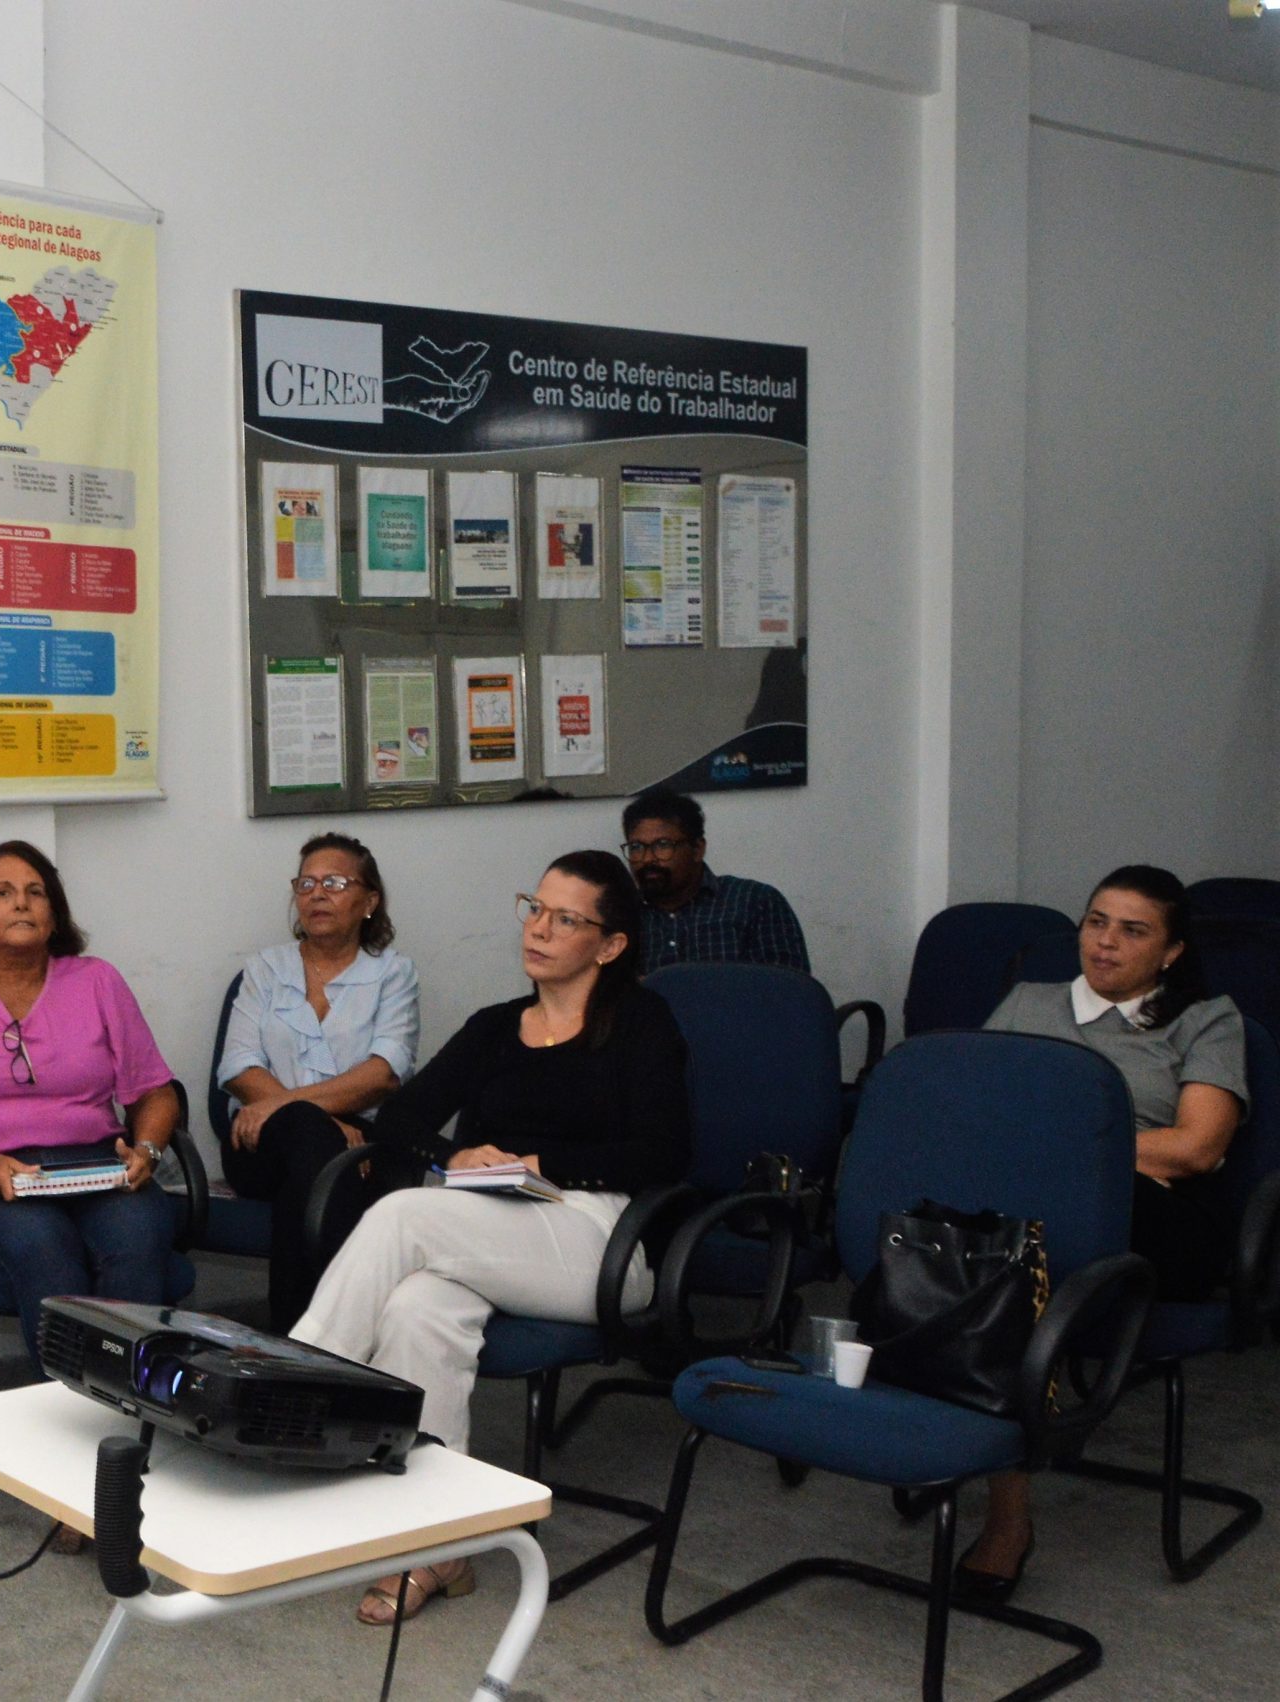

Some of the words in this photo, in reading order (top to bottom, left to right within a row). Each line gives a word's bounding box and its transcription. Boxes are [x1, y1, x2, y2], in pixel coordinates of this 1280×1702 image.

[28, 220, 52, 238] para
[56, 223, 82, 240] cada
[44, 238, 58, 253] de
[60, 240, 102, 263] Alagoas
[264, 358, 379, 409] CEREST
[508, 350, 580, 380] Centro
[584, 355, 608, 382] de
[614, 360, 716, 392] Referência
[720, 370, 798, 399] Estadual
[533, 386, 564, 405] em
[569, 383, 632, 410] Saúde
[637, 390, 662, 412] do
[668, 394, 778, 424] Trabalhador
[0, 444, 27, 454] ESTADUAL
[102, 1340, 124, 1357] EPSON
